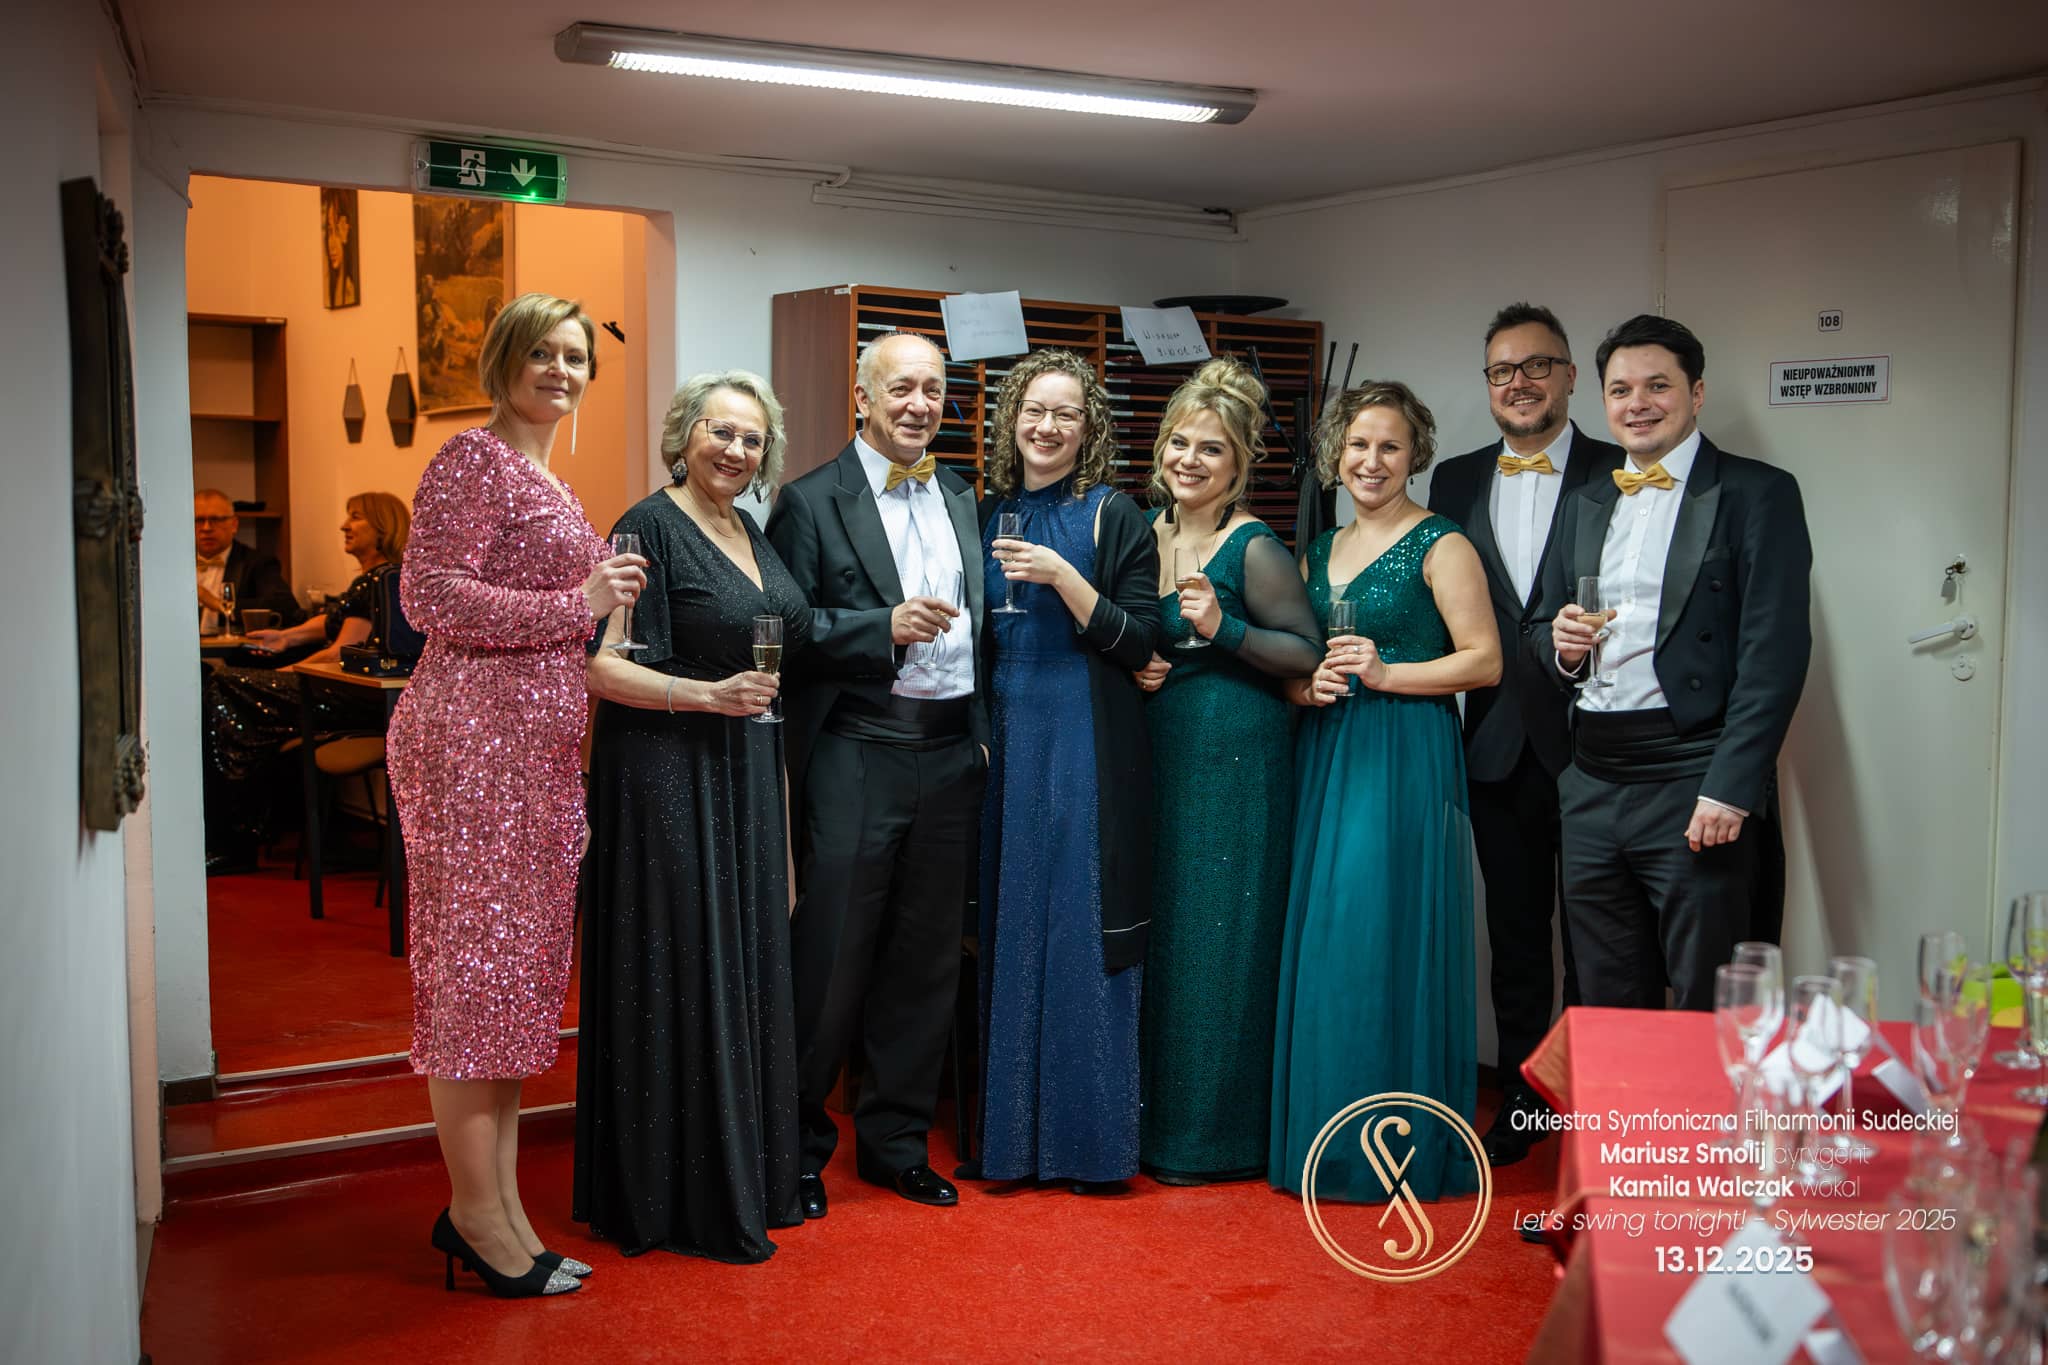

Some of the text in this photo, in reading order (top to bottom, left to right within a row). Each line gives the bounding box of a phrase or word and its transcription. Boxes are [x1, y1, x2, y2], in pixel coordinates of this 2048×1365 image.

[1820, 315, 1840, 327] 108
[1783, 364, 1875, 381] NIEUPOWAŻNIONYM
[1780, 381, 1877, 399] WSTĘP WZBRONIONY
